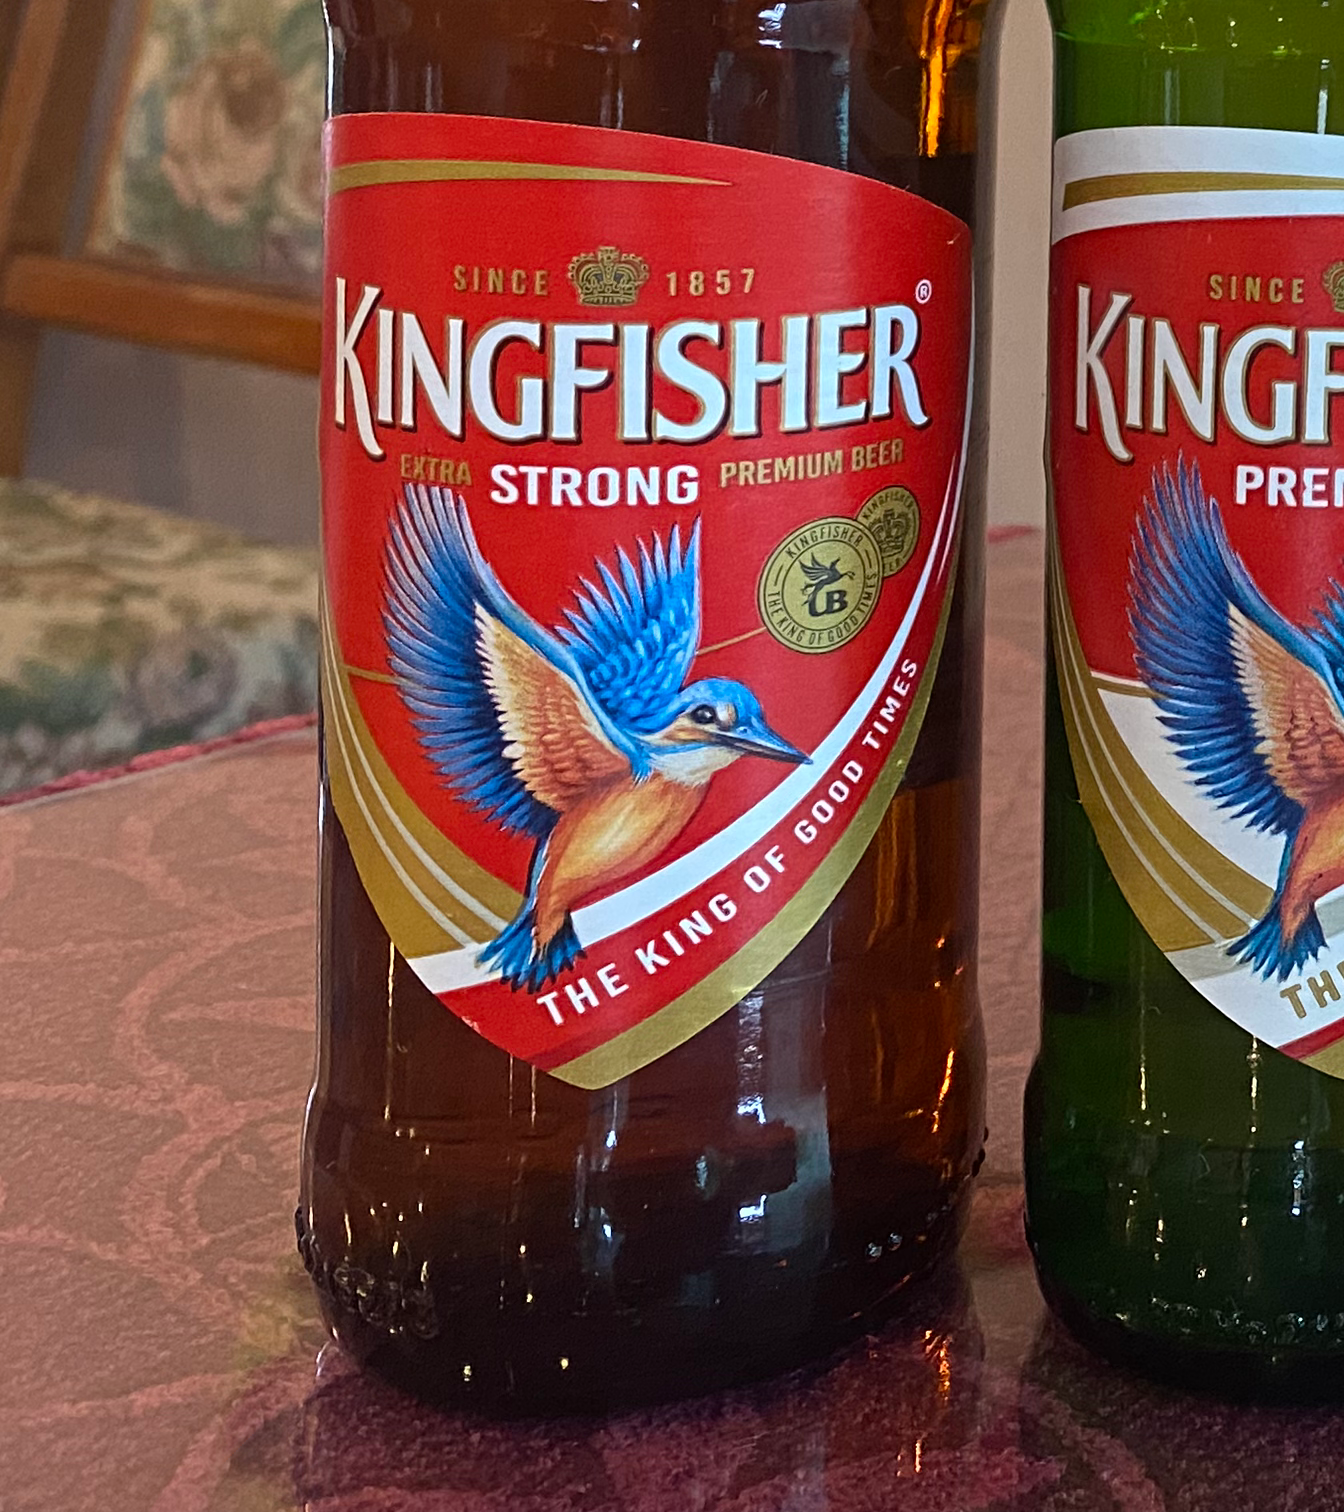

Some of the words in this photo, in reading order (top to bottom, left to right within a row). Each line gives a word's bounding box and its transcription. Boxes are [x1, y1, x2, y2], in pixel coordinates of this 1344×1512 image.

[454, 264, 549, 296] SINCE
[665, 268, 756, 297] 1857
[1210, 275, 1305, 304] SINCE
[334, 277, 931, 462] KINGFISHER
[401, 453, 473, 487] EXTRA
[489, 464, 699, 508] STRONG
[719, 451, 843, 488] PREMIUM
[851, 440, 905, 470] BEER
[785, 525, 864, 560] KINGFISHER
[767, 591, 782, 616] THE
[776, 615, 806, 643] KING
[808, 632, 822, 645] OF
[828, 615, 859, 643] GOOD
[536, 963, 629, 1026] THE
[635, 892, 738, 976] KING
[743, 845, 787, 894] OF
[794, 760, 864, 845] GOOD
[862, 658, 918, 750] TIMES
